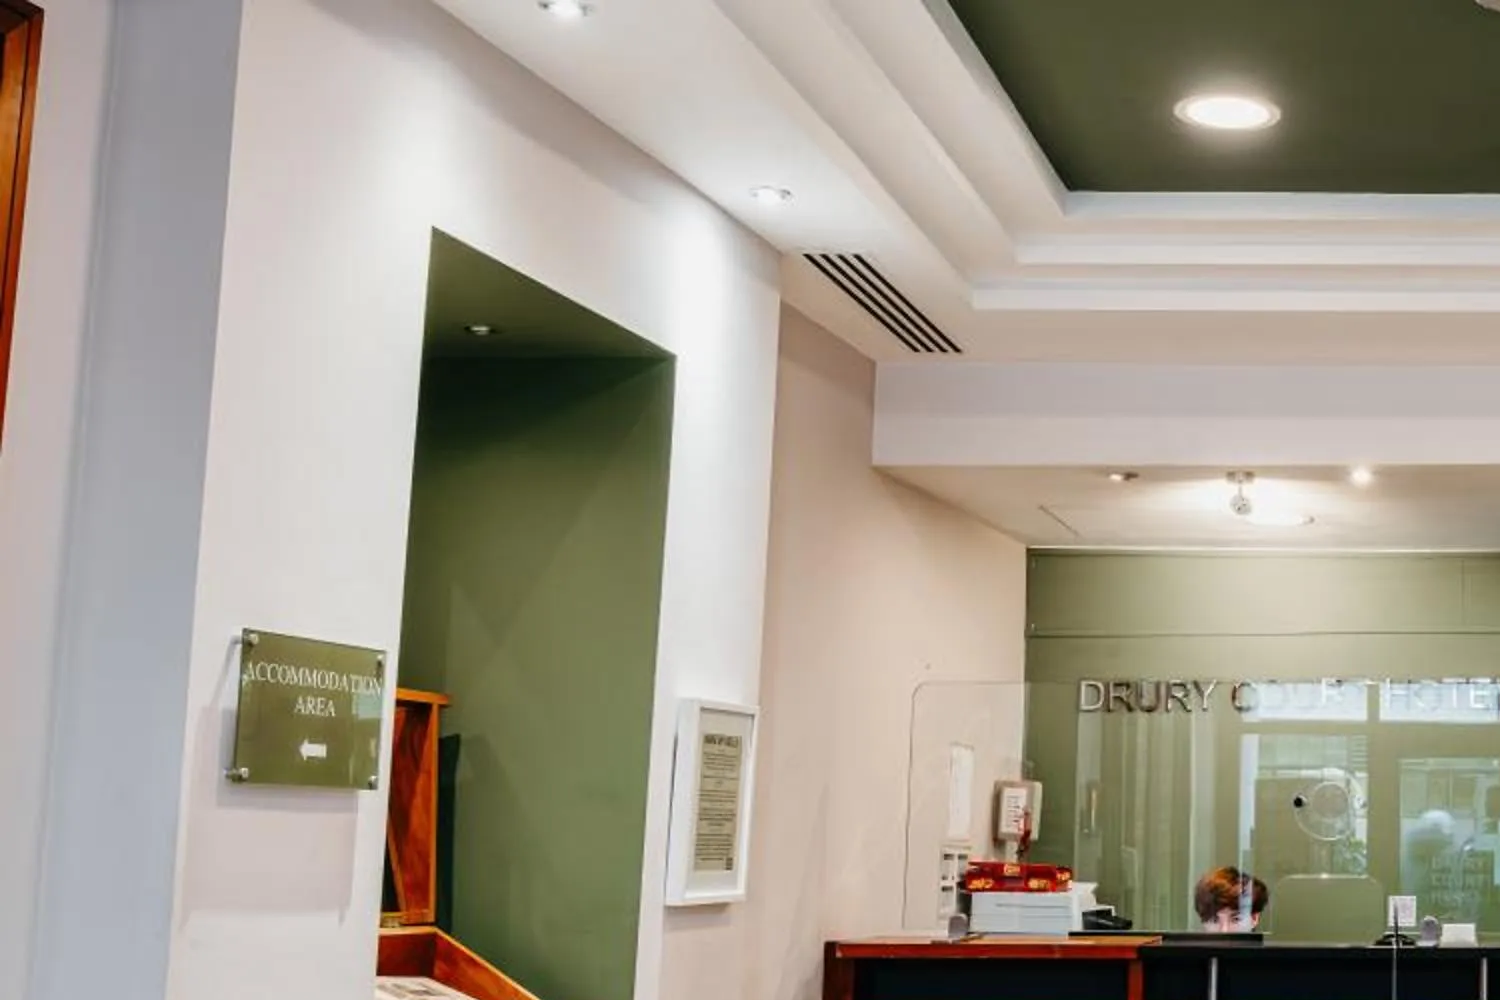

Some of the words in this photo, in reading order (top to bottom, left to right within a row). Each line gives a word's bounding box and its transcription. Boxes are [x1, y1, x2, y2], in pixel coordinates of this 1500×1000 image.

[246, 661, 382, 694] ACCOMMODATION
[295, 696, 336, 716] AREA
[1077, 678, 1218, 714] DRURY
